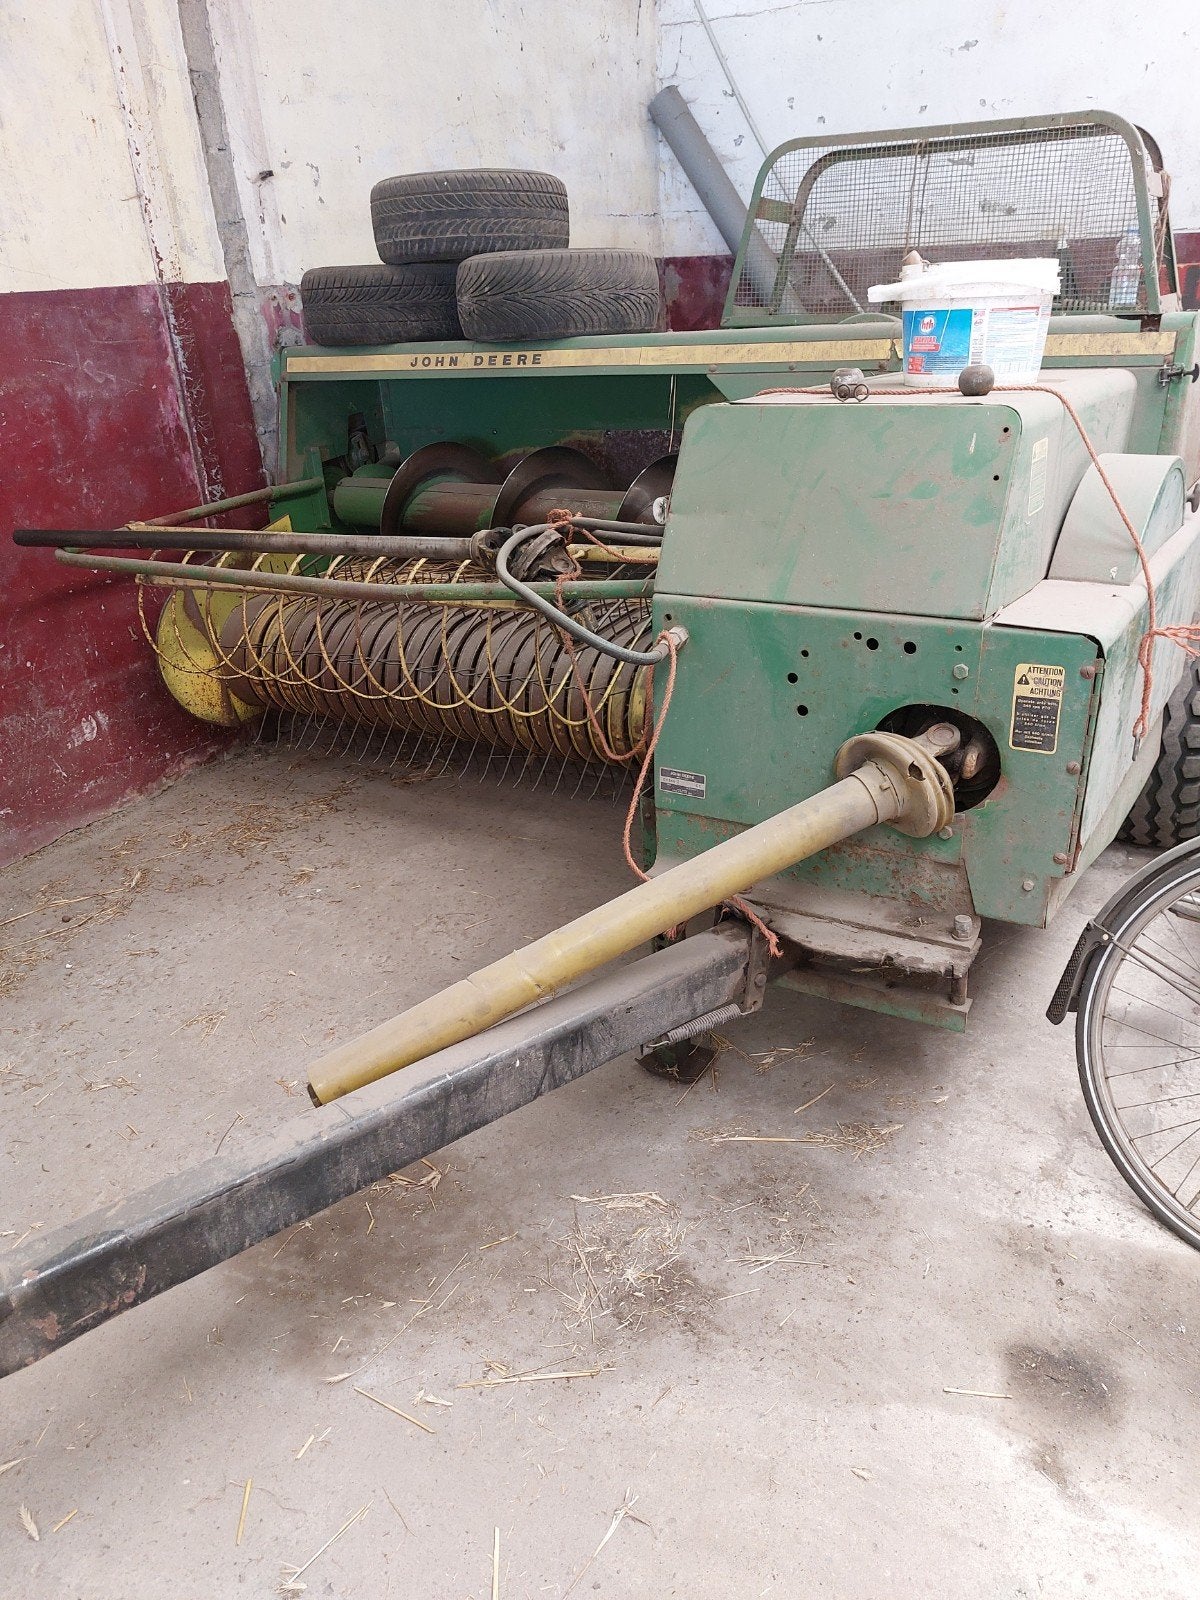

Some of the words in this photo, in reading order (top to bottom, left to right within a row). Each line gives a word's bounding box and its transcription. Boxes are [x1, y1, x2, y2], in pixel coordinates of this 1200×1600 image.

[921, 319, 934, 330] hth
[410, 356, 458, 368] JOHN
[473, 353, 542, 367] DEERE
[1027, 666, 1064, 676] ATTENTION
[1033, 677, 1062, 687] CAUTION
[1029, 687, 1061, 697] ACHTUNG
